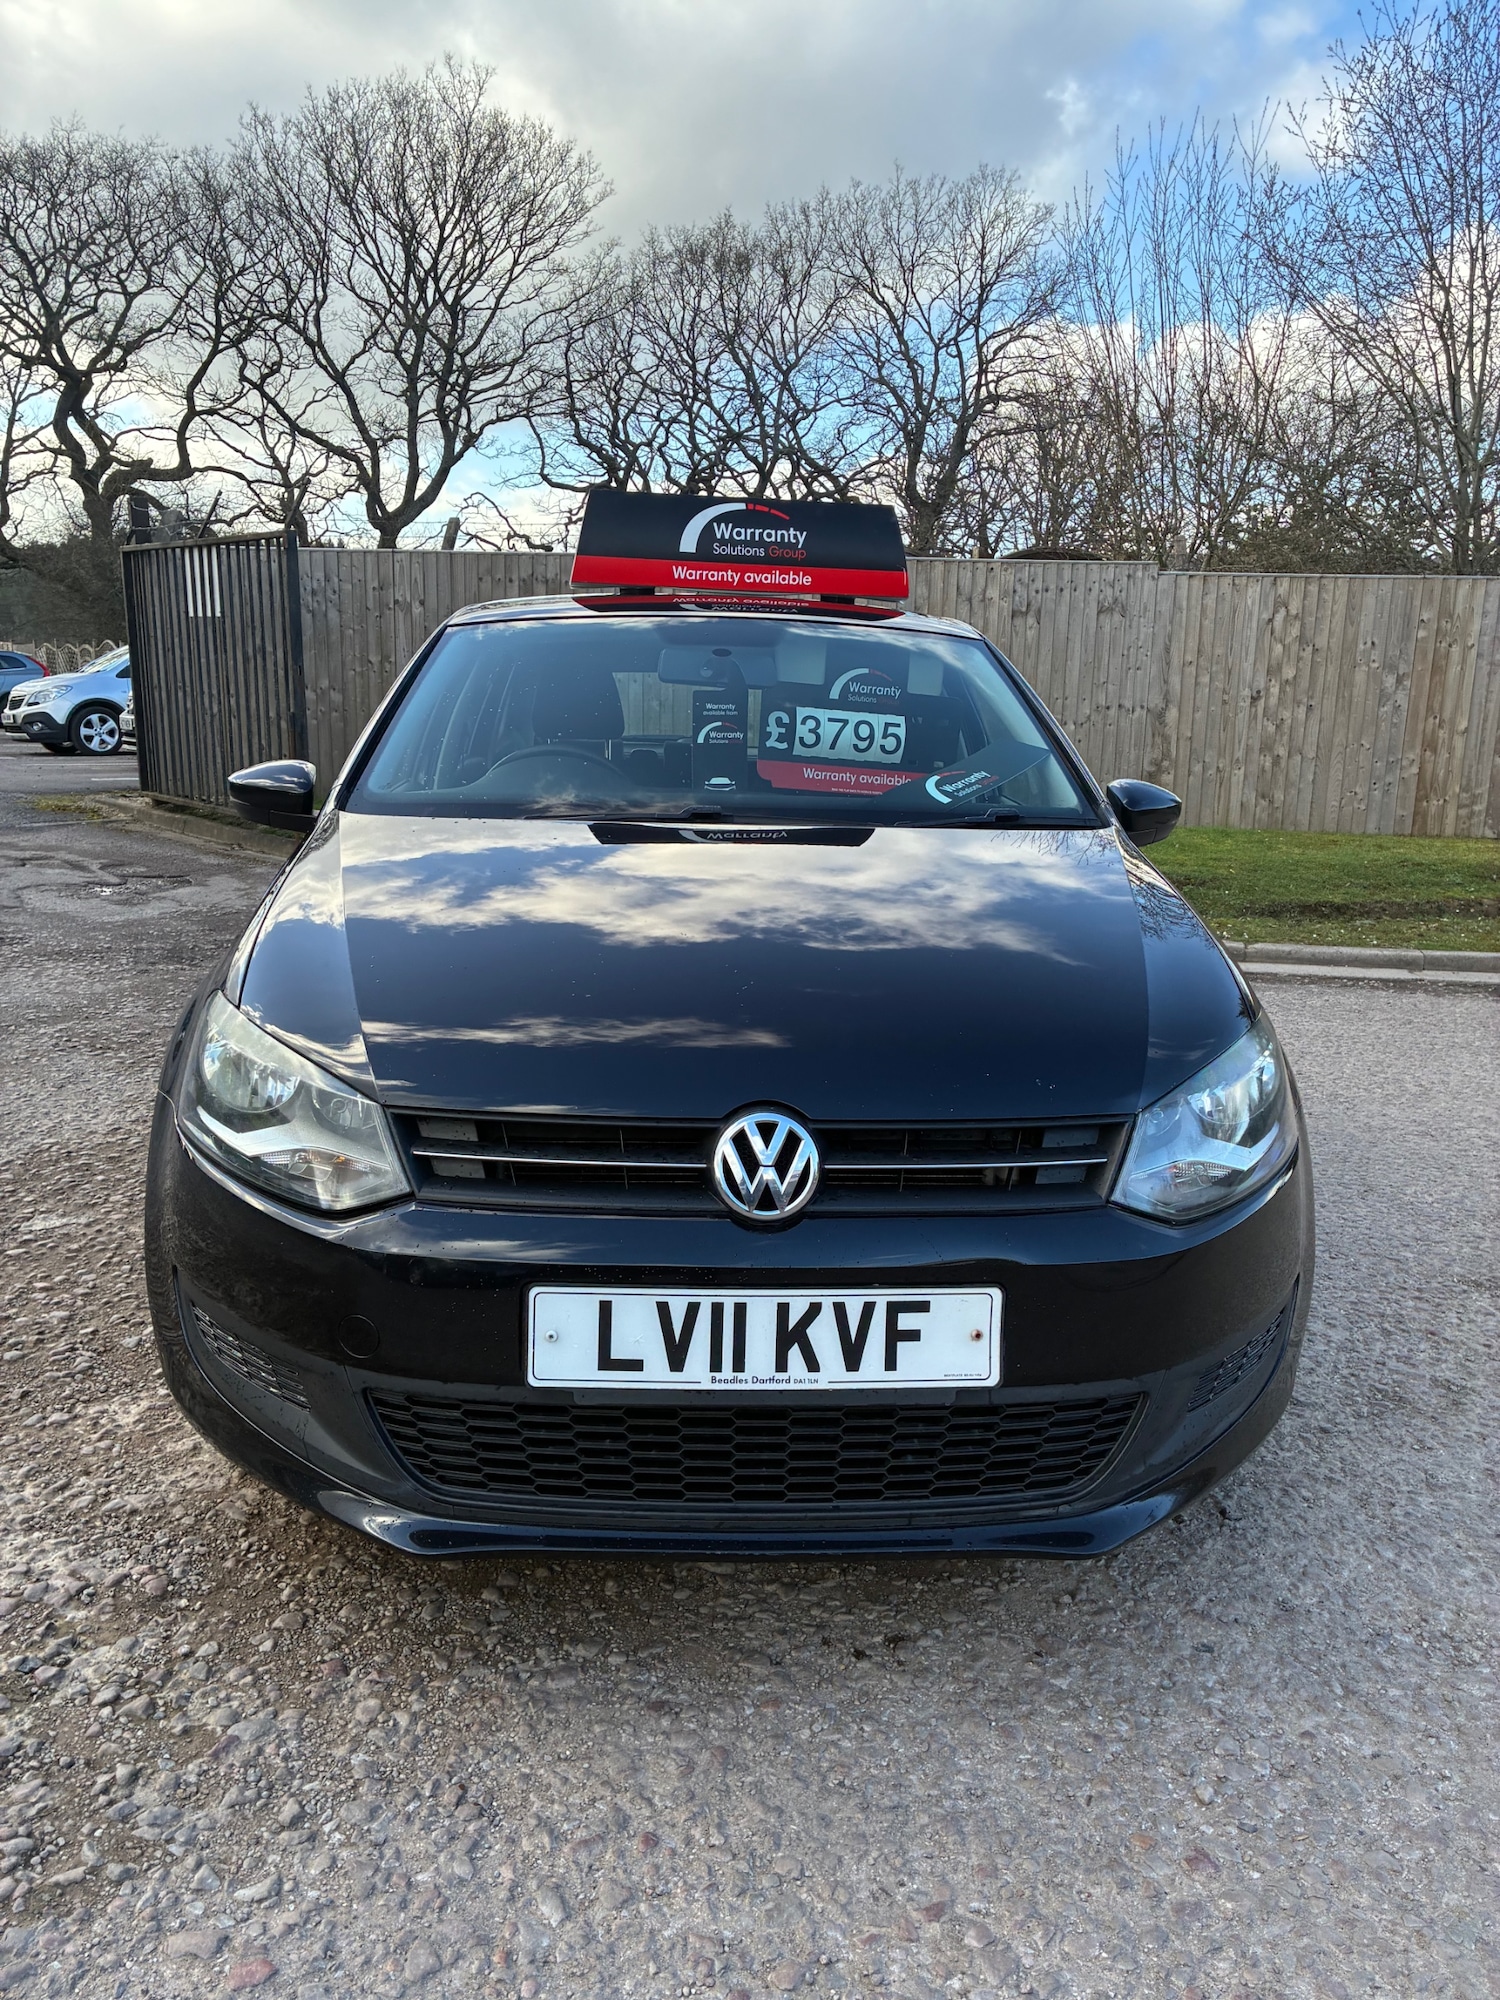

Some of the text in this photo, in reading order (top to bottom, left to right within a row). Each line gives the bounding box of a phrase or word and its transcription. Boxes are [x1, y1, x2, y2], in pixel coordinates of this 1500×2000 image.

[713, 522, 807, 548] Warranty
[713, 543, 807, 560] Solutions Group
[672, 565, 812, 586] Warranty available
[847, 693, 877, 703] Solutions
[848, 681, 902, 700] Warranty
[705, 703, 736, 712] Warranty
[708, 731, 744, 740] Warranty
[765, 710, 902, 755] £3795
[803, 767, 857, 786] Warranty
[939, 770, 991, 793] Warranty
[775, 1300, 931, 1373] KVF
[710, 1375, 748, 1384] Beadles
[751, 1375, 791, 1384] Dartford
